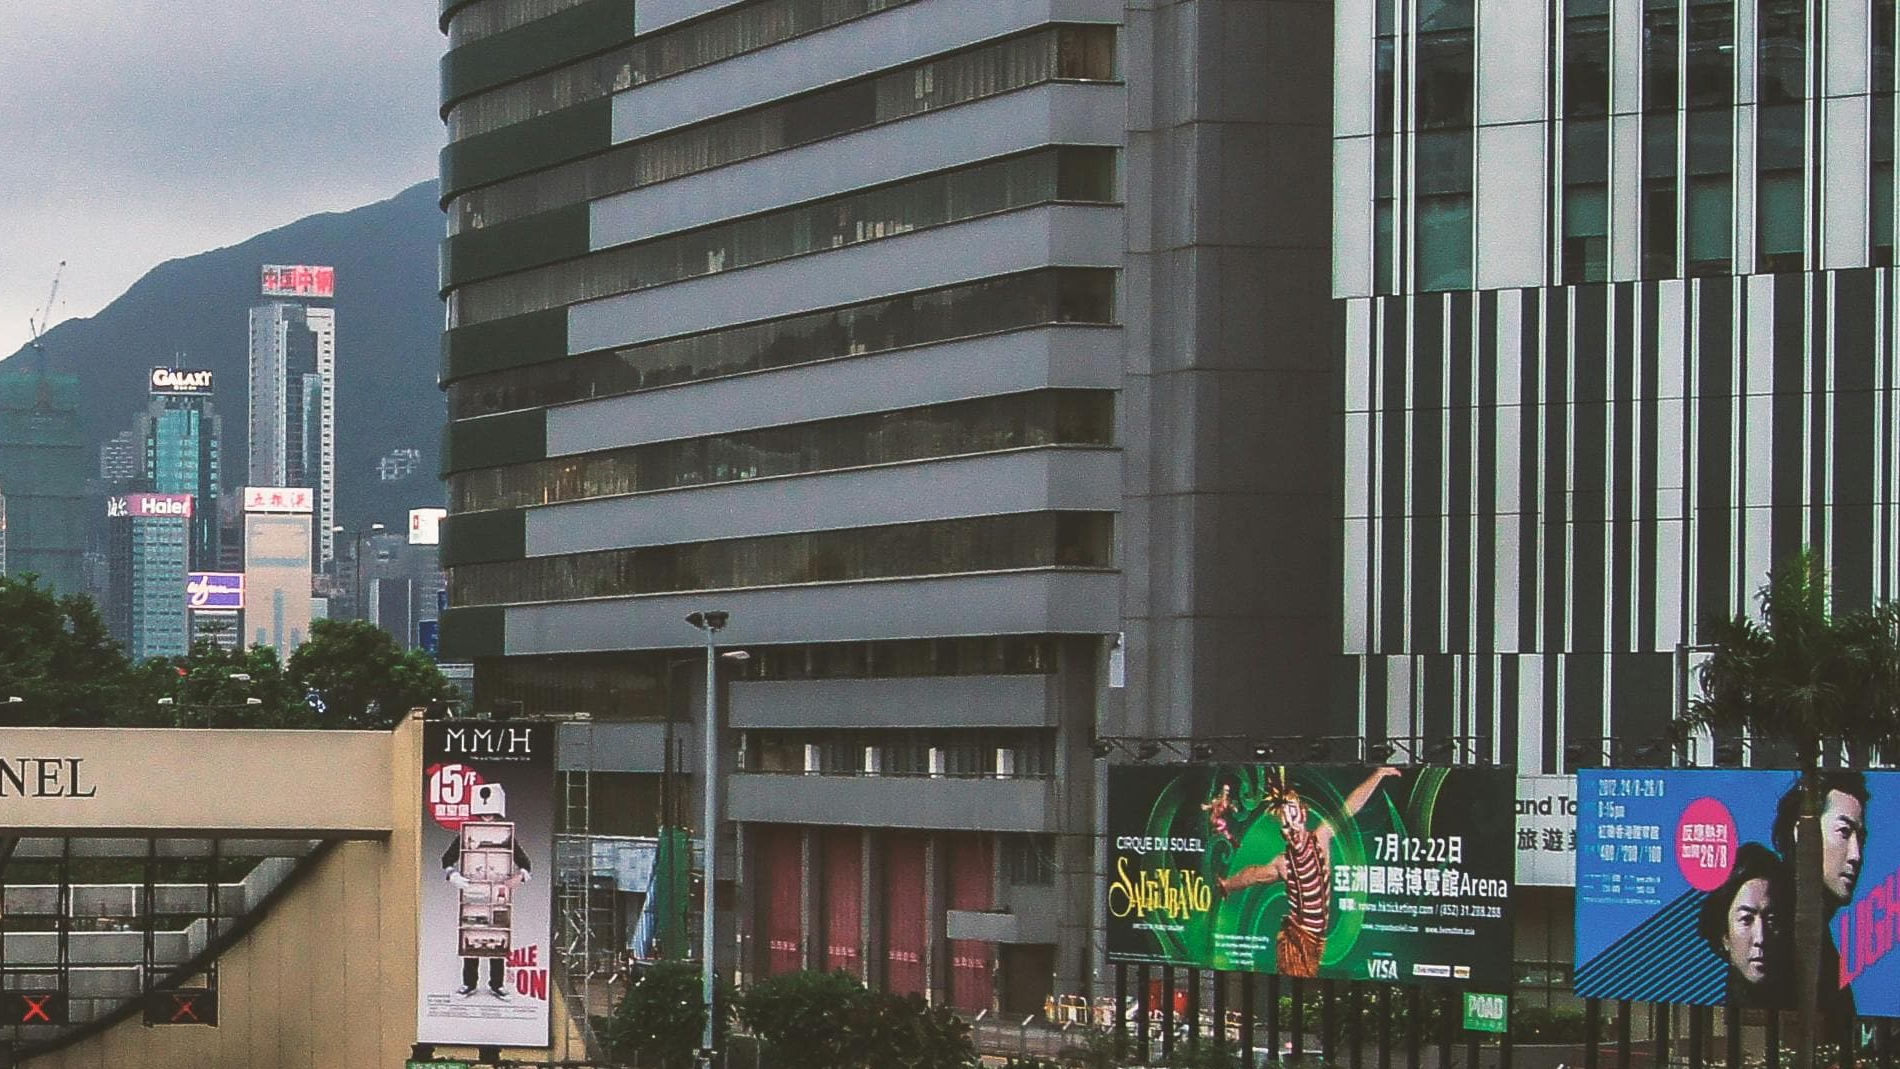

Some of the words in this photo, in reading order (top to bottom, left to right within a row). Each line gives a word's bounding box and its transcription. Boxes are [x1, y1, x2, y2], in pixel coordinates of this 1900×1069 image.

[152, 369, 213, 387] GALAXY
[141, 497, 187, 515] Haier
[1116, 836, 1153, 855] CIRQUE
[1154, 837, 1169, 852] DU
[1170, 837, 1206, 853] SOLEIL
[1367, 959, 1398, 980] VISA
